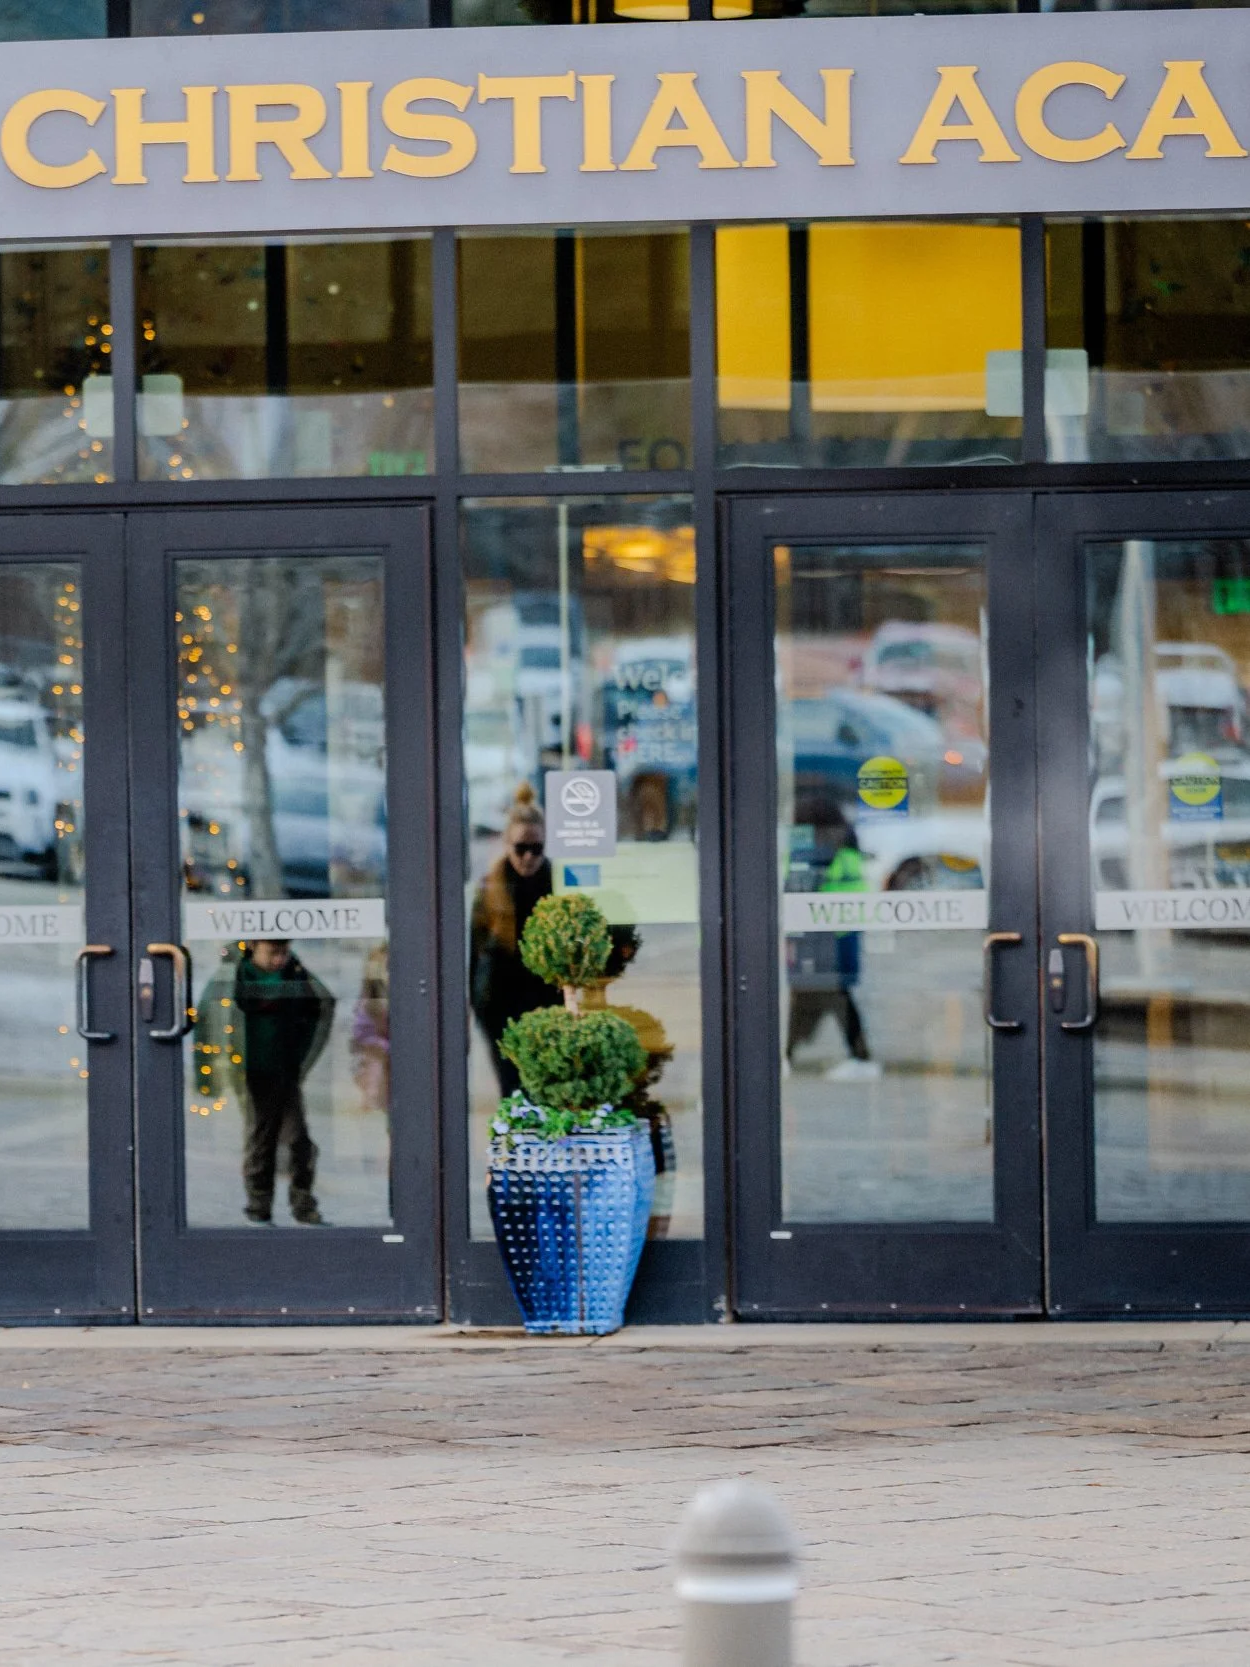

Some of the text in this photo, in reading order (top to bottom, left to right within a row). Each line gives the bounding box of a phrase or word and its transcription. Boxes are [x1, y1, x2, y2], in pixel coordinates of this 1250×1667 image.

[0, 68, 856, 188] CHRISTIAN
[899, 60, 1250, 164] ACA
[210, 907, 361, 932] WELCOME
[807, 899, 964, 924] WELCOME
